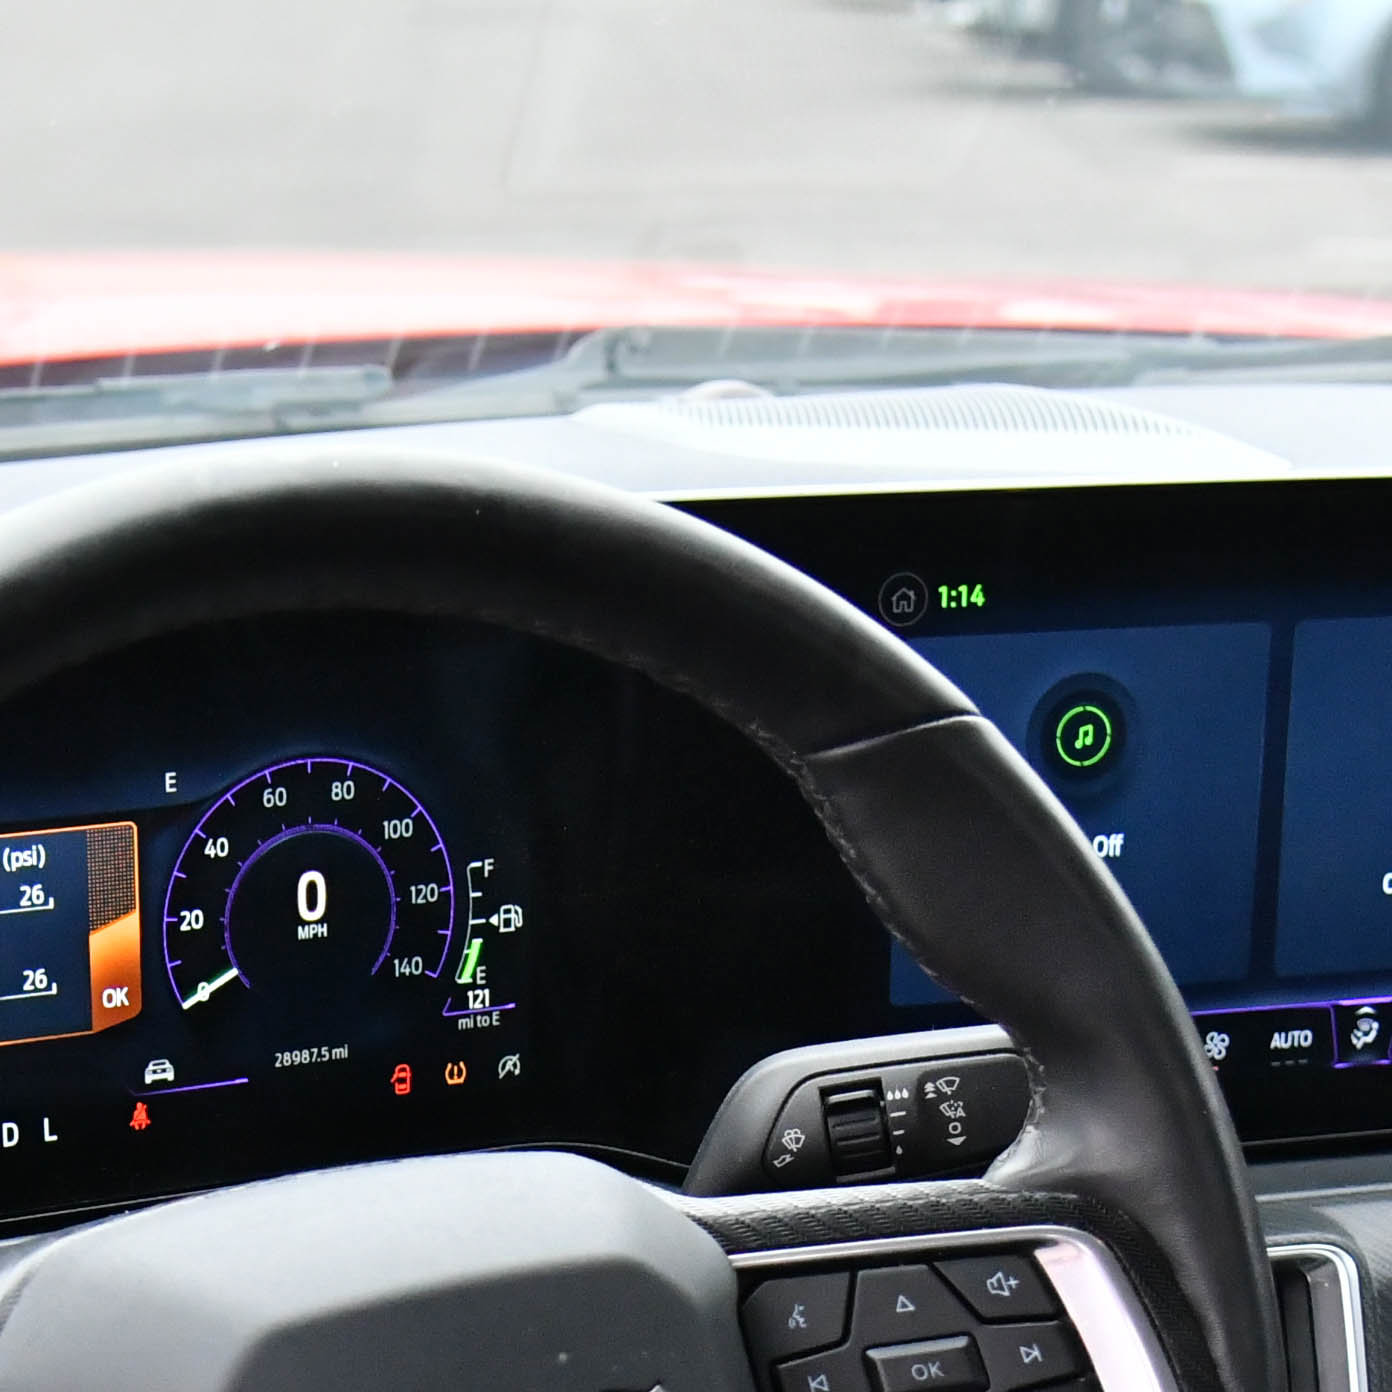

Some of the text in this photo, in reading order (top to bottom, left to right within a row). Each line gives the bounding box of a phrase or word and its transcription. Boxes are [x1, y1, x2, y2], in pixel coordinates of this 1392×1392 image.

[938, 583, 985, 608] 1:14
[164, 772, 177, 793] E
[331, 780, 356, 801] 80
[263, 787, 288, 808] 60
[382, 818, 414, 840] 100
[204, 837, 229, 859] 40
[1093, 833, 1124, 858] Off
[2, 844, 47, 872] (psi)
[484, 859, 494, 877] F
[19, 883, 45, 907] 26
[296, 869, 328, 922] 0
[409, 882, 439, 905] 120
[179, 909, 205, 932] 20
[297, 923, 328, 941] MPH
[393, 956, 423, 978] 140
[476, 966, 486, 985] E
[22, 968, 48, 992] 26
[101, 987, 129, 1009] OK
[467, 988, 490, 1009] 121
[458, 1011, 500, 1030] mi to E
[1270, 1030, 1313, 1051] AUTO
[274, 1044, 349, 1068] 28987.5 mi
[2, 1122, 20, 1147] D
[43, 1117, 58, 1142] L
[911, 1361, 944, 1381] OK
